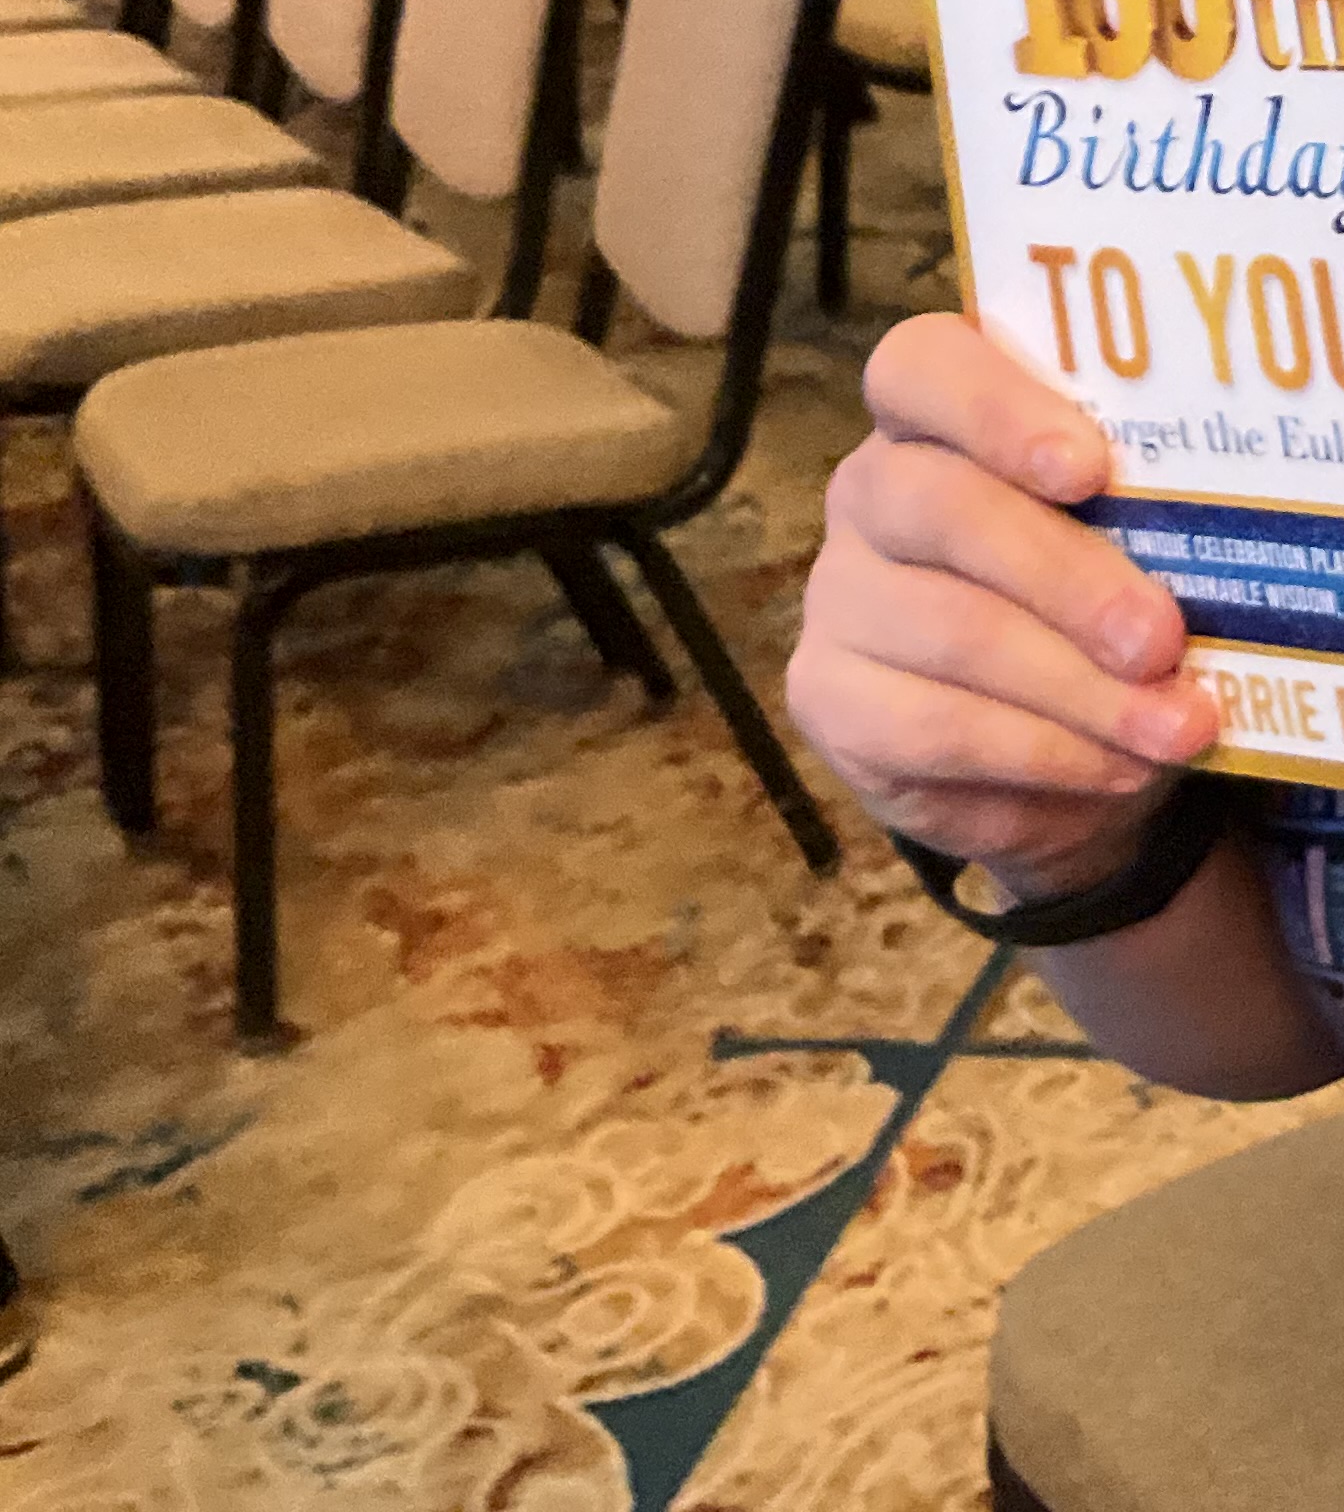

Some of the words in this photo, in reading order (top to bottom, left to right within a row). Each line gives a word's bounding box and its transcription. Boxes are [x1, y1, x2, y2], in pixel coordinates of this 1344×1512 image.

[1028, 243, 1151, 380] TO
[1203, 411, 1265, 456] the
[1192, 534, 1308, 571] CELEBRATION
